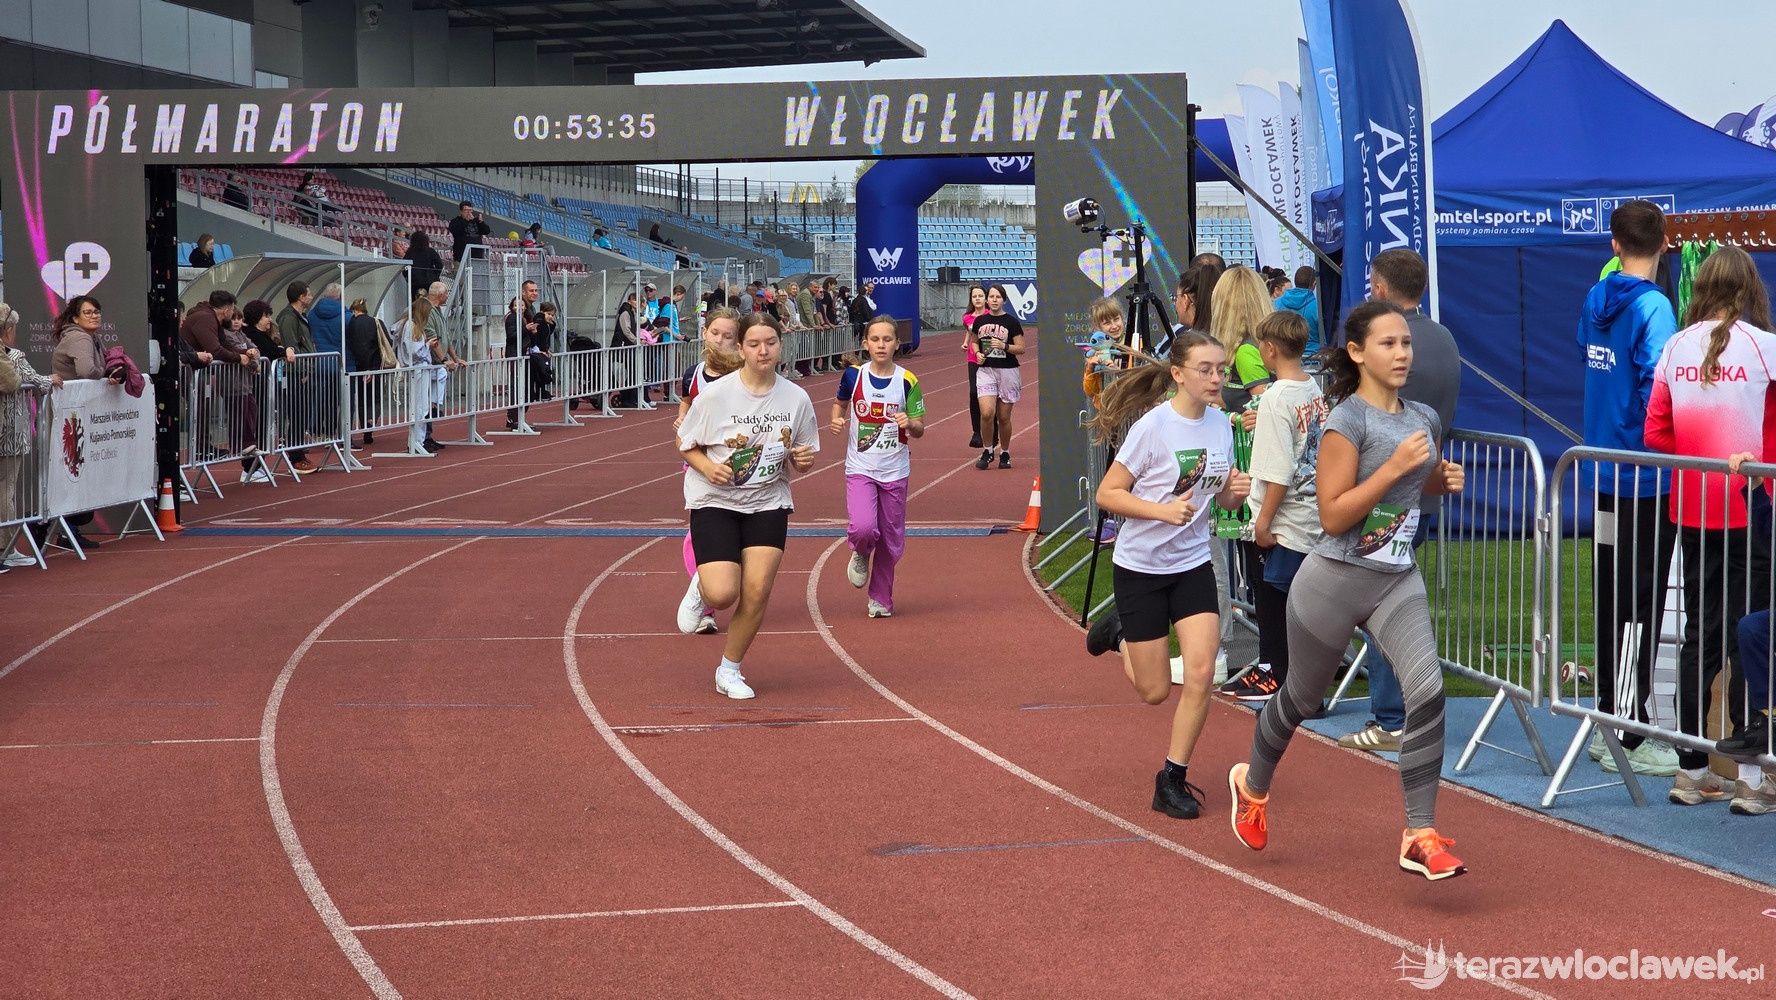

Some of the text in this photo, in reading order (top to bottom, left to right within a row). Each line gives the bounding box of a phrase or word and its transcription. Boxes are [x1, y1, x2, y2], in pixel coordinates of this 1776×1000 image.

[47, 96, 403, 155] PÓŁMARATON
[513, 112, 657, 140] 00:53:35
[785, 89, 1122, 146] WŁOCŁAWEK
[1473, 226, 1508, 236] pomiaru
[1511, 226, 1535, 234] czasu
[730, 411, 791, 427] Teddy Social
[751, 422, 774, 436] Club
[875, 438, 898, 450] 474
[757, 460, 783, 478] 287
[1200, 474, 1223, 491] 174
